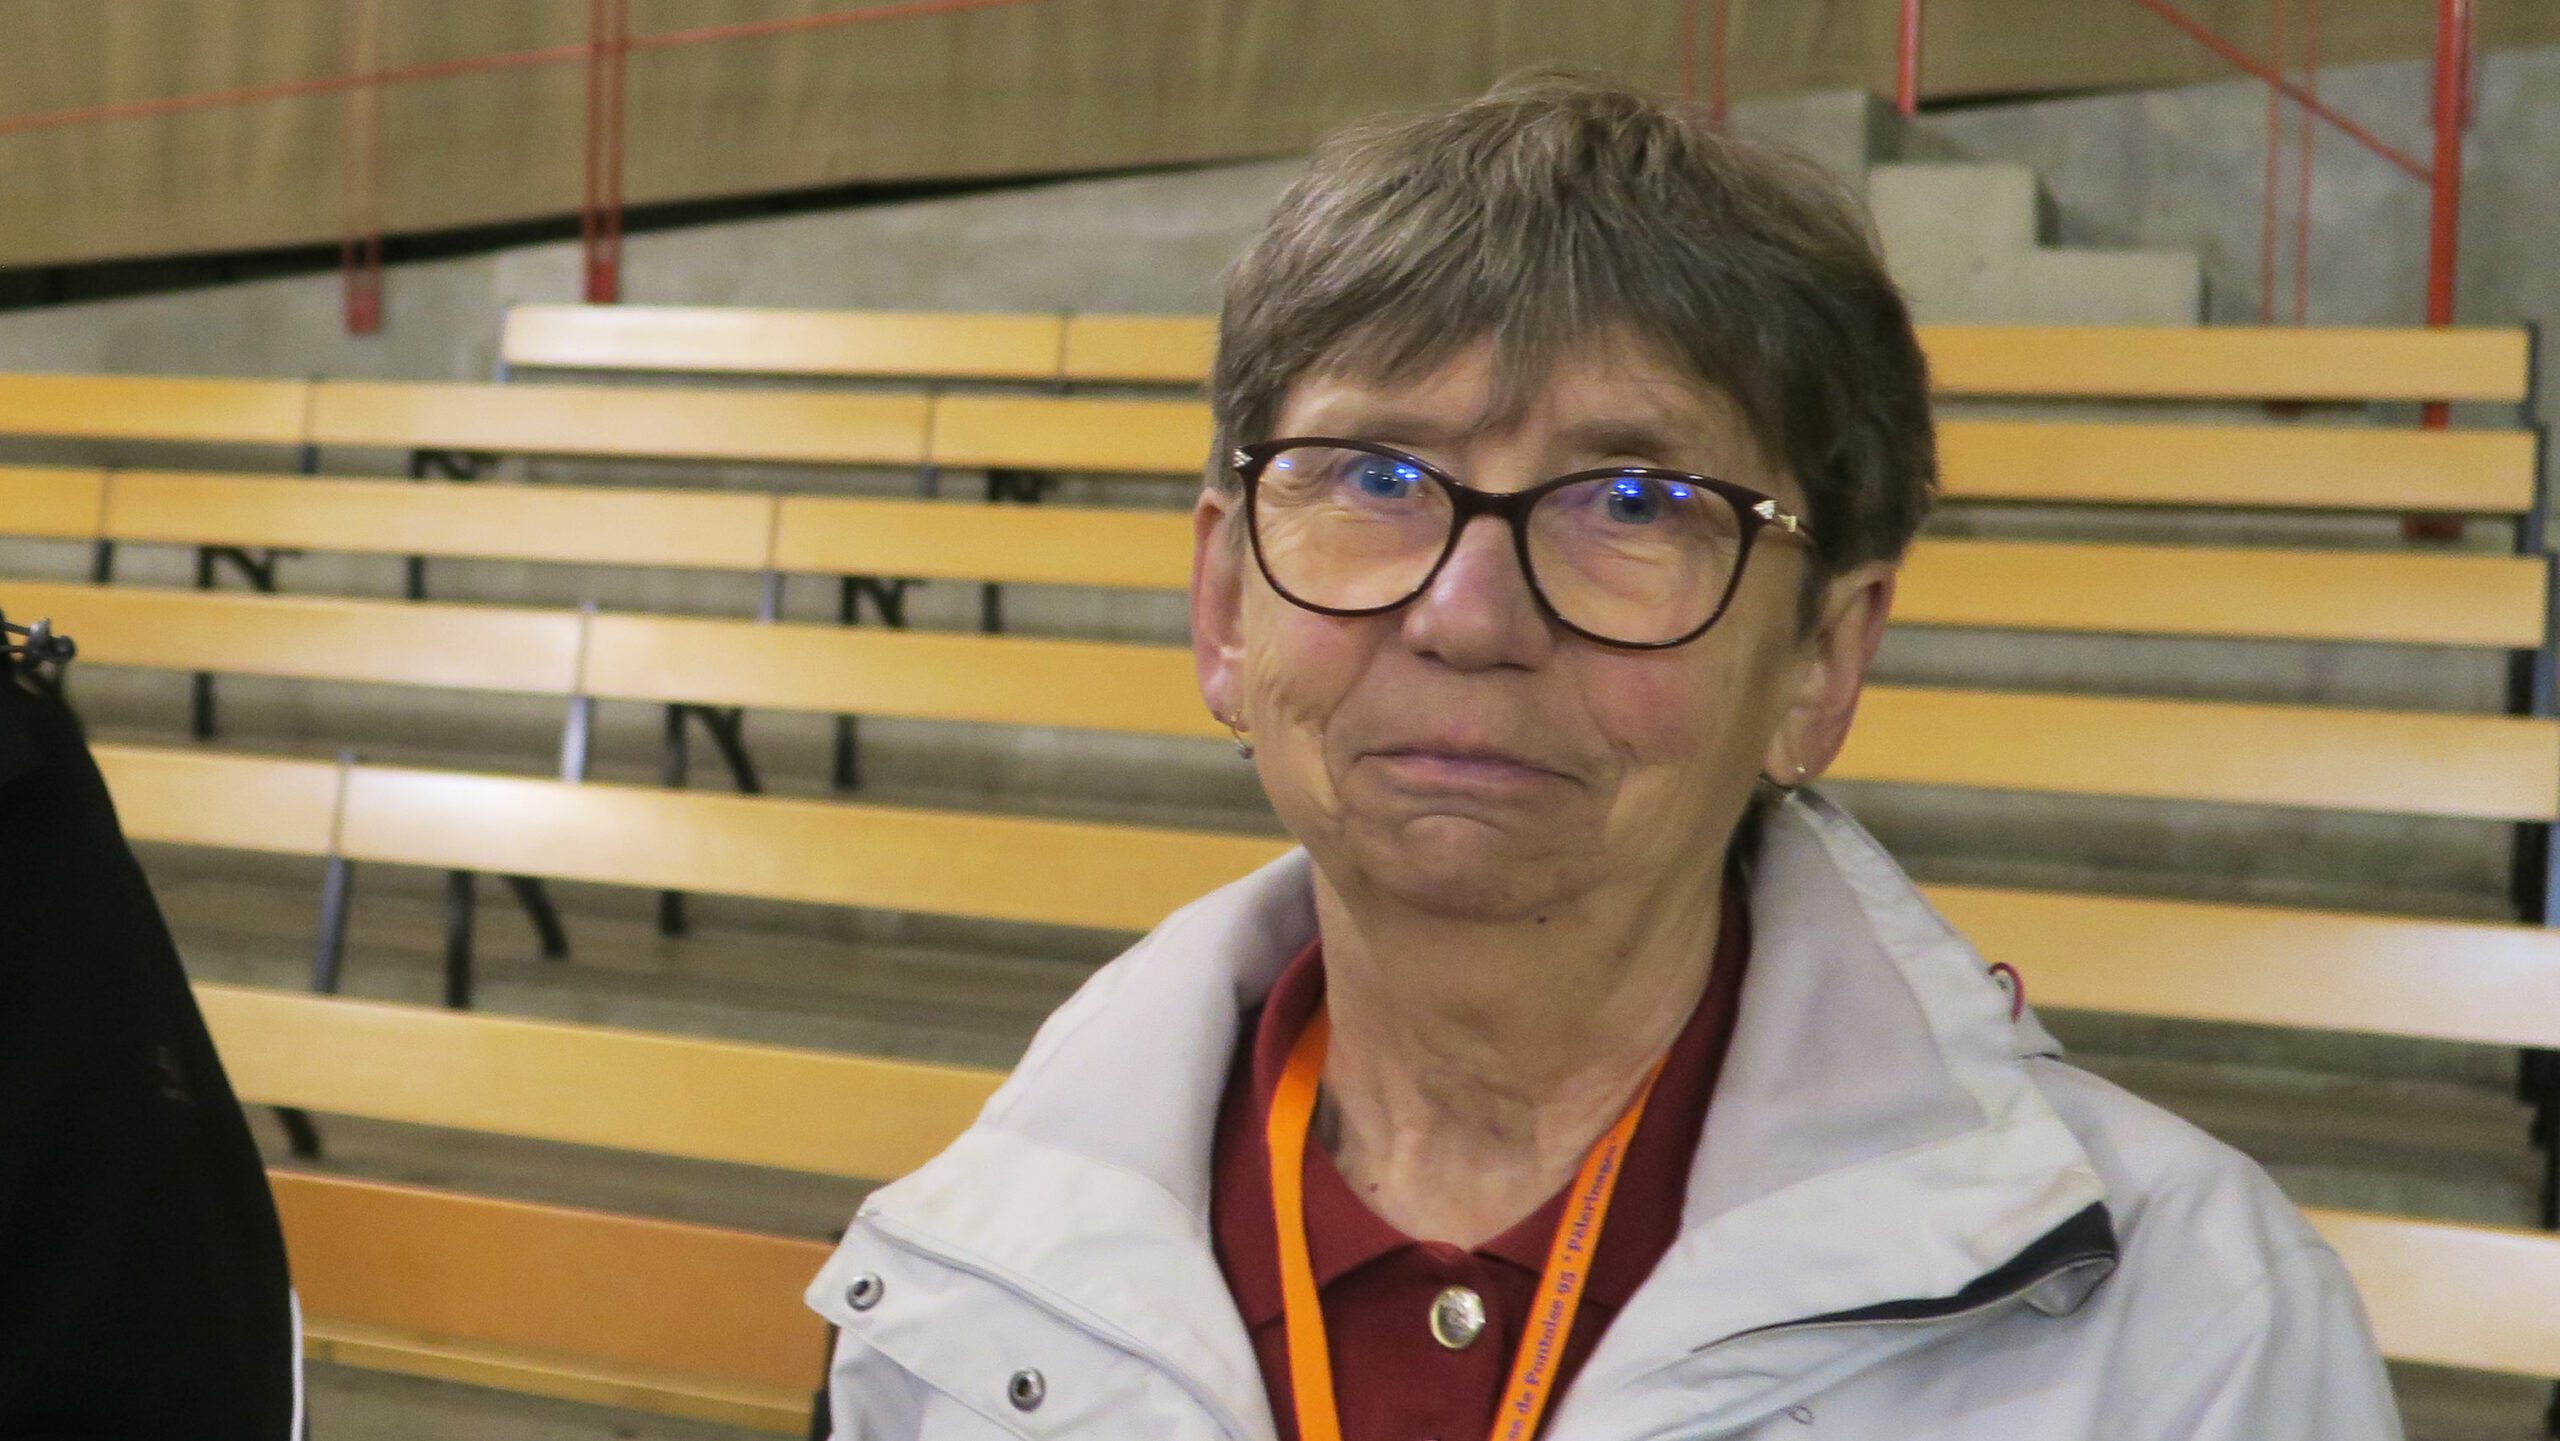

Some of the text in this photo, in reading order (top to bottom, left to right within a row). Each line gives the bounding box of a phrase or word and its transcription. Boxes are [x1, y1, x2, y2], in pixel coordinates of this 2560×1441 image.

[1557, 1271, 1577, 1294] 95
[1525, 1300, 1564, 1386] Pontoise
[1516, 1391, 1535, 1414] de
